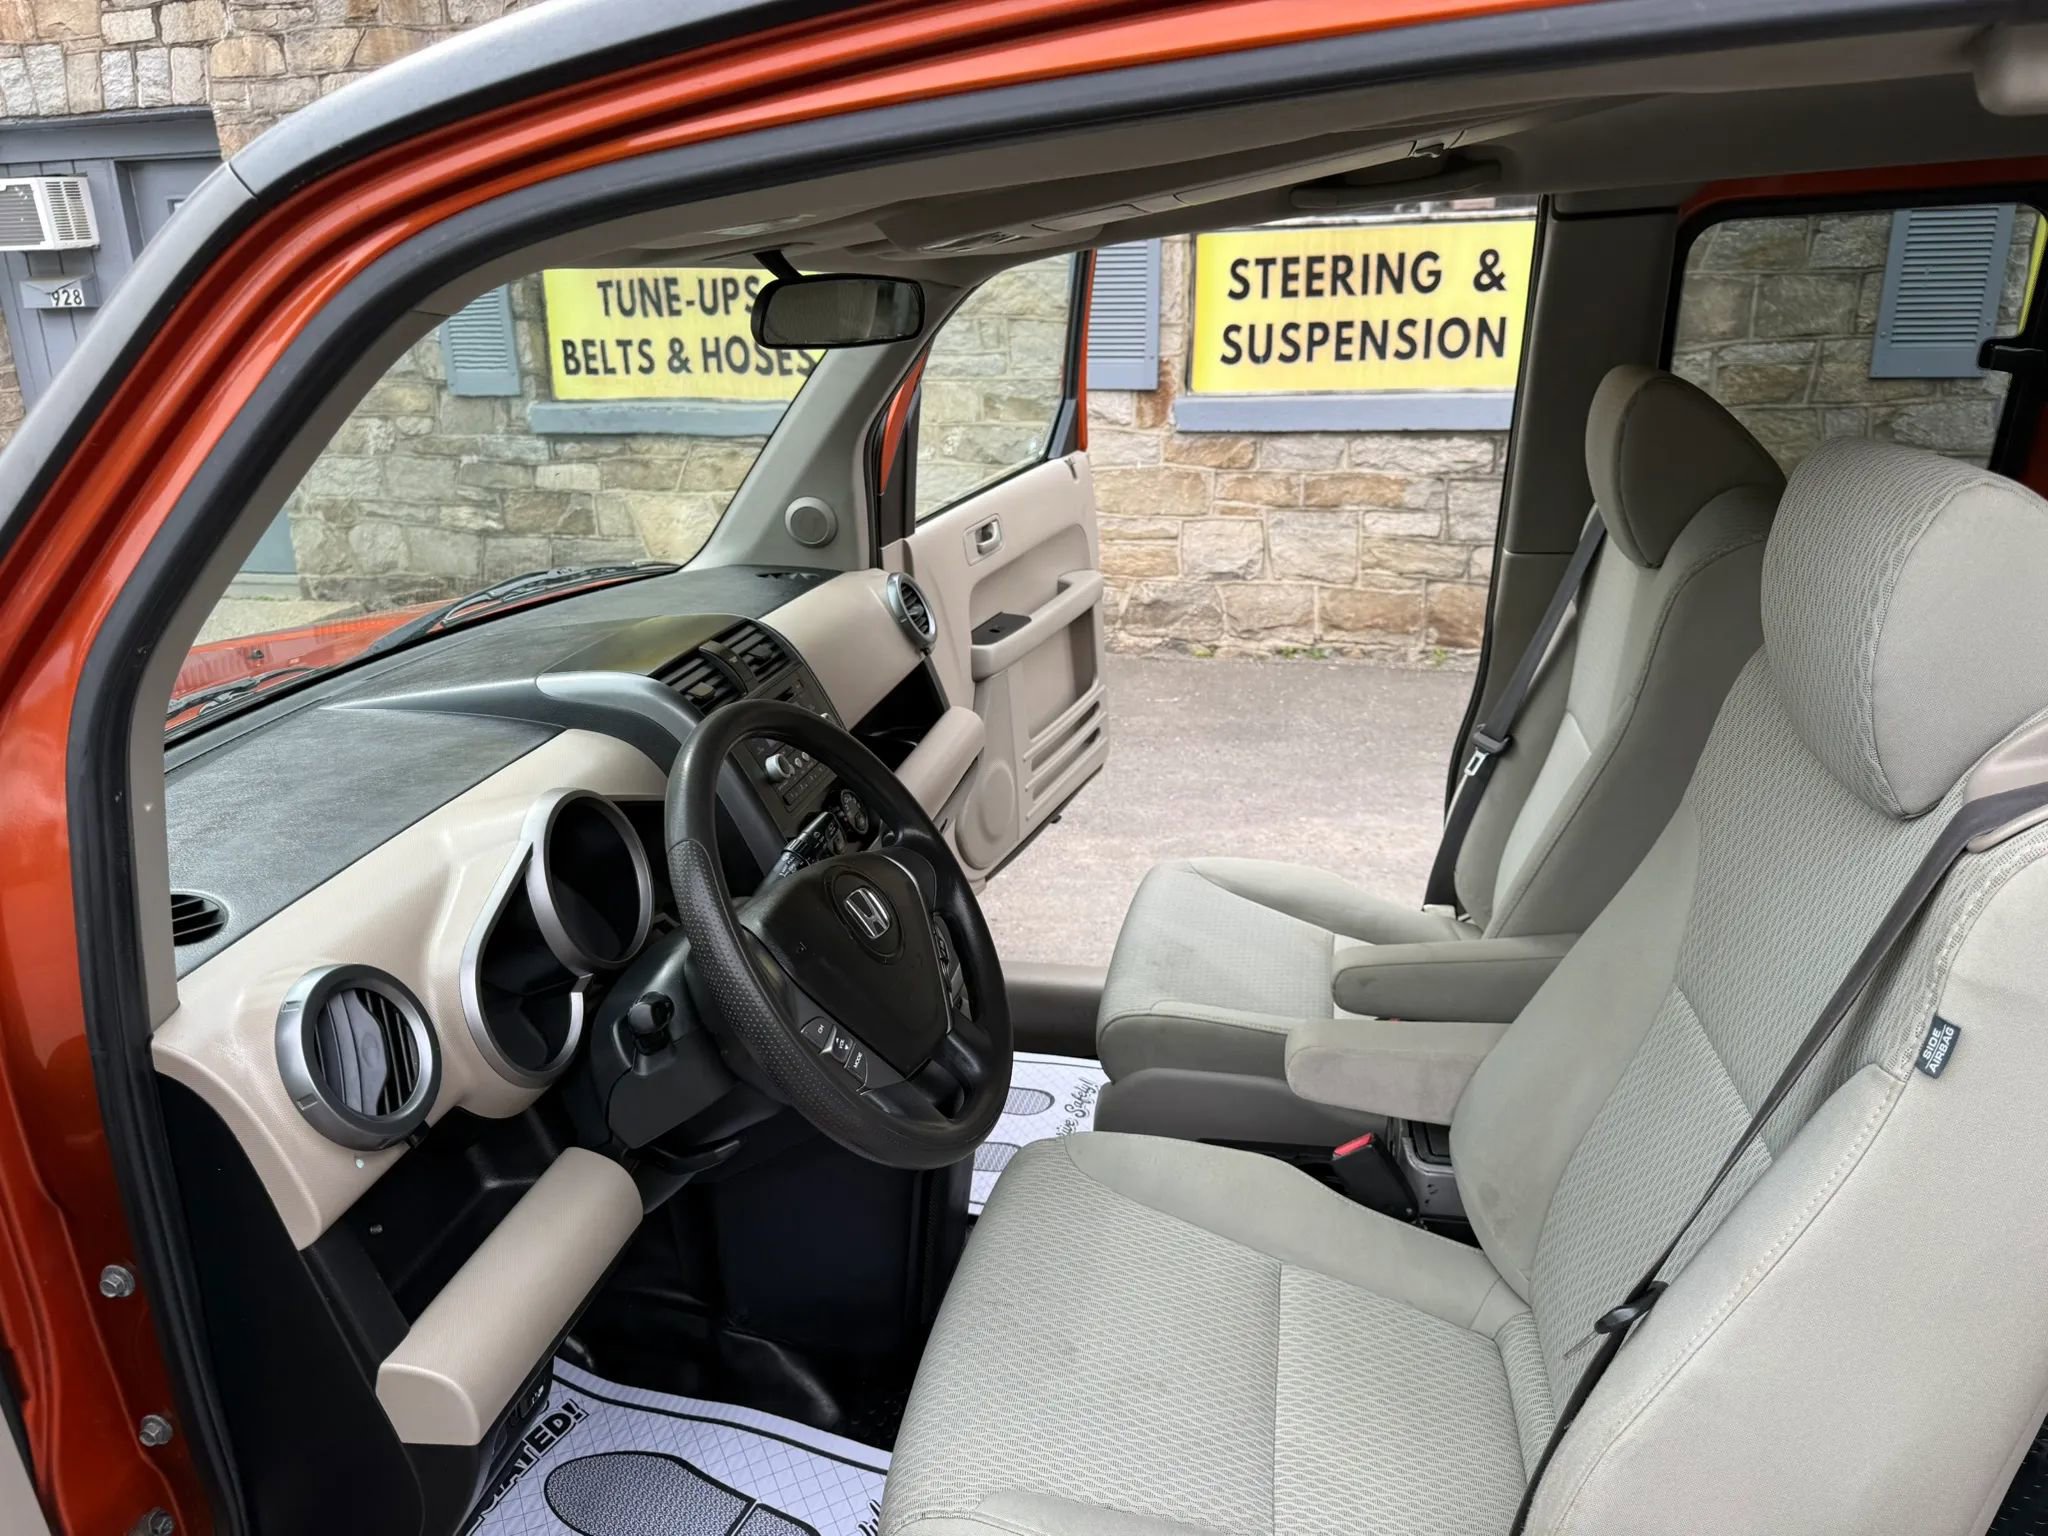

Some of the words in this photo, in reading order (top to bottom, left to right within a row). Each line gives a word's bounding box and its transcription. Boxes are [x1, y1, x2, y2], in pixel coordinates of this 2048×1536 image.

[1228, 251, 1441, 300] STEERING
[1473, 248, 1507, 293] &
[52, 289, 82, 306] 928
[597, 275, 760, 318] TUNE-UPS
[561, 338, 654, 376] BELTS
[667, 337, 693, 374] &
[701, 336, 817, 376] HOSES
[1220, 317, 1507, 365] SUSPENSION
[1922, 1028, 1941, 1059] SIDE
[1929, 1026, 1954, 1073] AIRBAG
